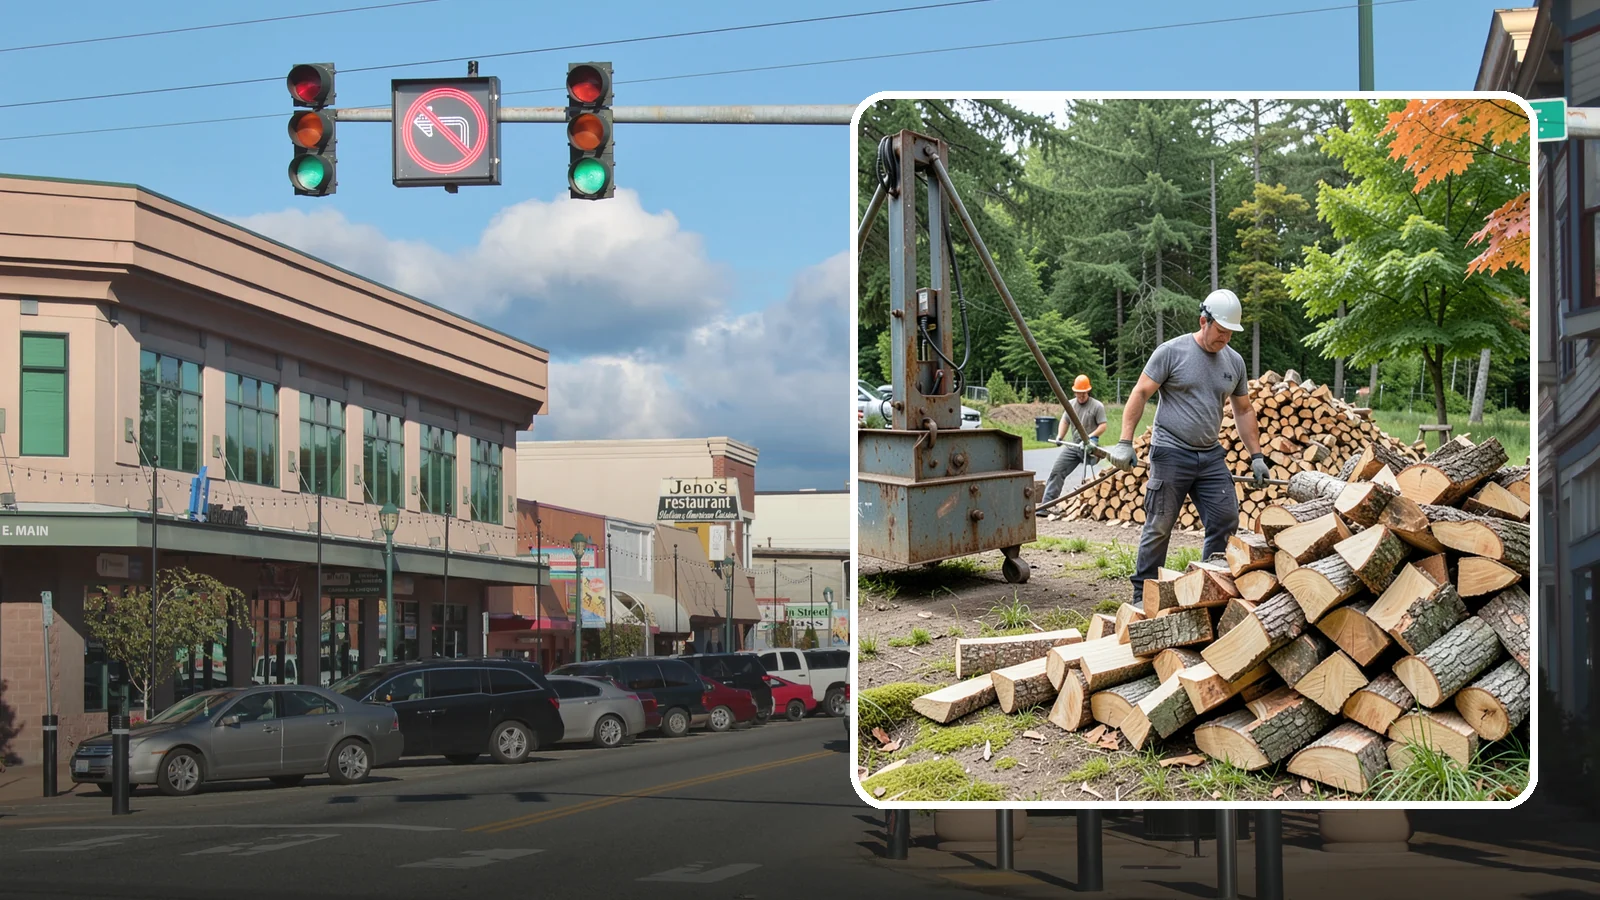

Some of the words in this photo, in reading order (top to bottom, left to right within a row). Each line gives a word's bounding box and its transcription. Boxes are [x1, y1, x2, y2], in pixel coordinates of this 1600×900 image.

[670, 480, 727, 494] Jeno's
[665, 496, 731, 509] restaurant
[659, 510, 681, 519] Italian
[686, 510, 714, 519] American
[715, 510, 737, 519] Cuisine
[2, 525, 13, 536] E.
[15, 525, 49, 536] MAIN
[797, 607, 828, 617] Street
[790, 619, 824, 627] lass
